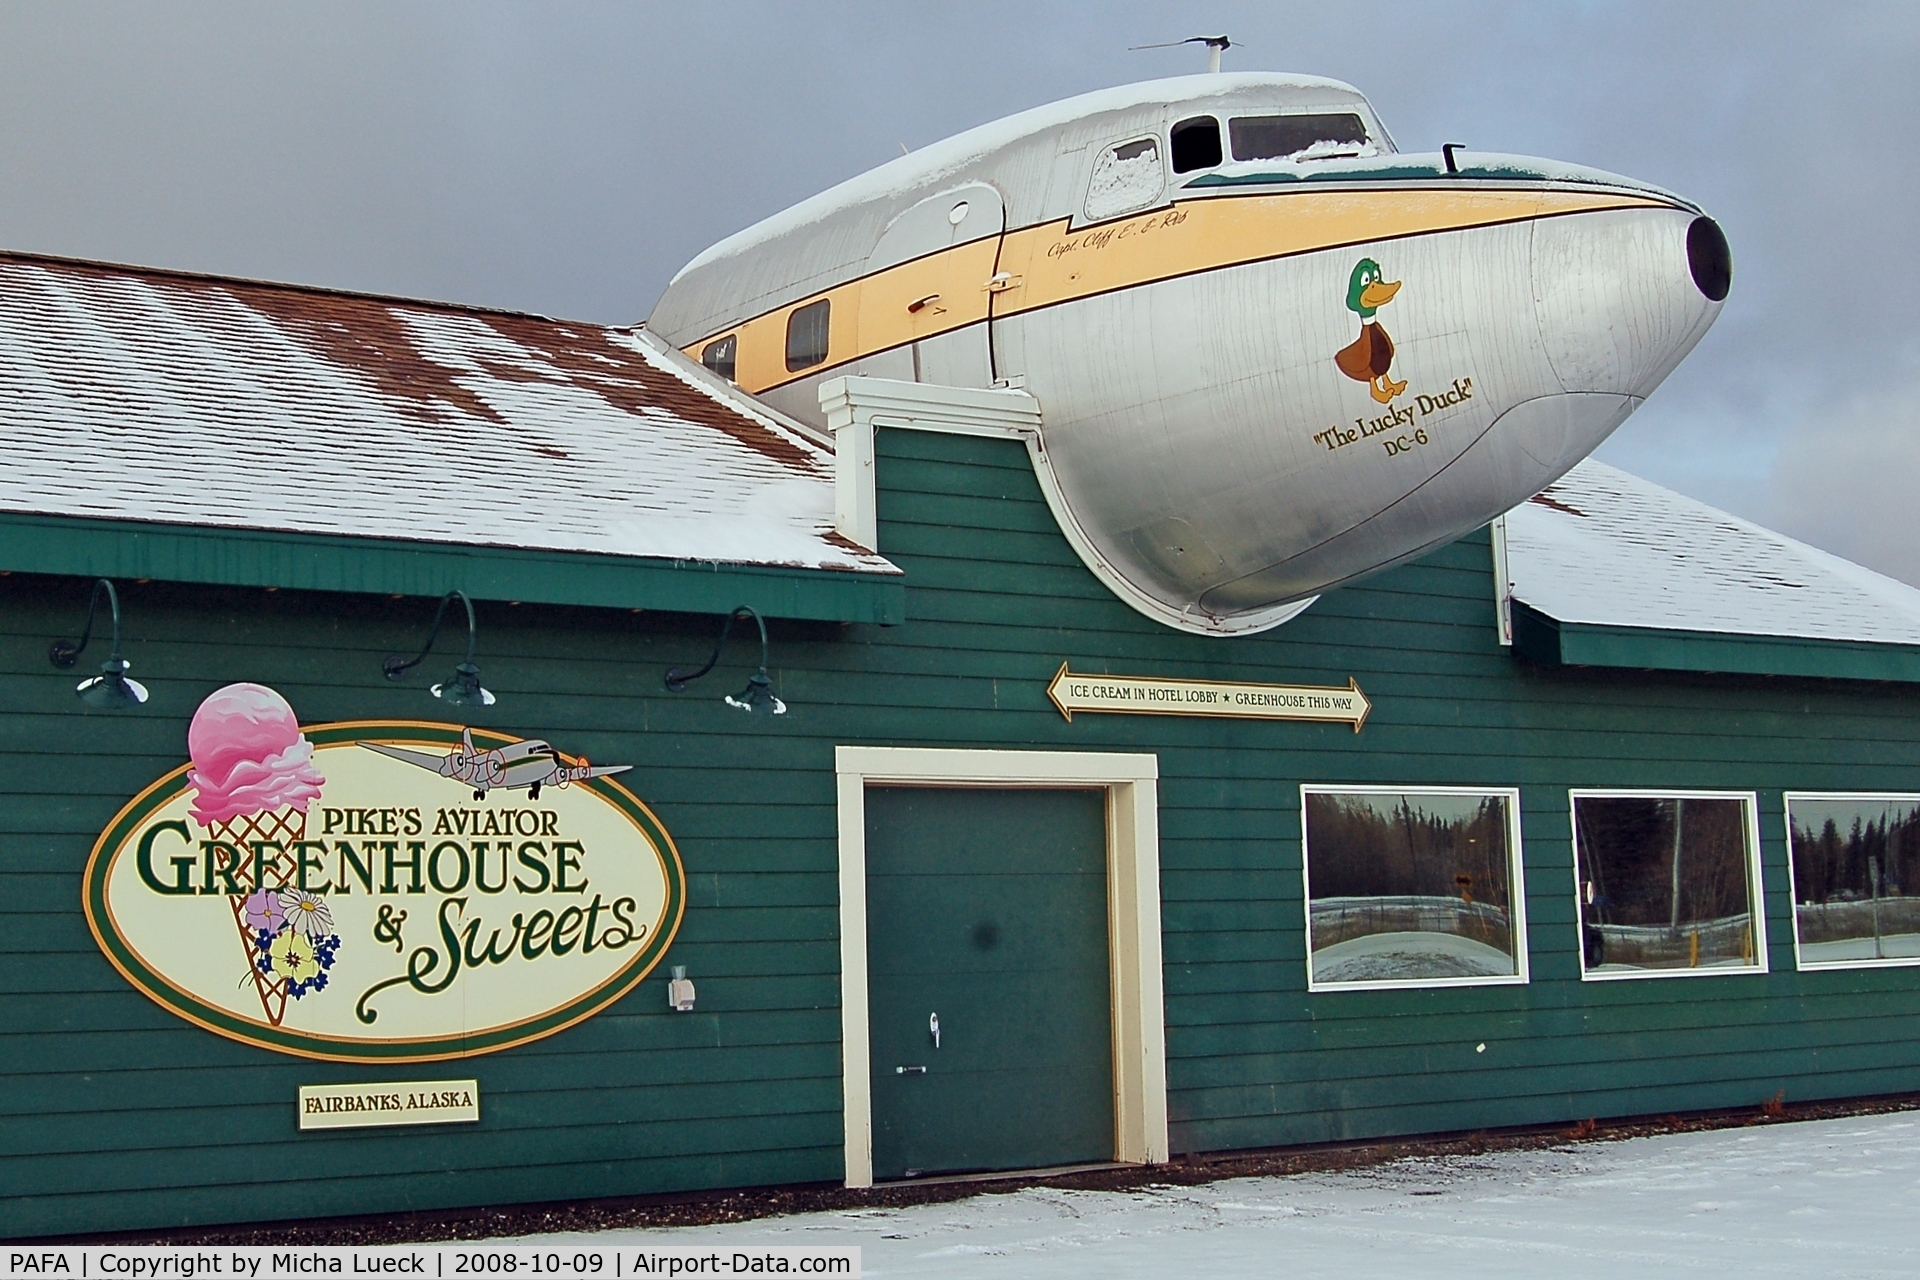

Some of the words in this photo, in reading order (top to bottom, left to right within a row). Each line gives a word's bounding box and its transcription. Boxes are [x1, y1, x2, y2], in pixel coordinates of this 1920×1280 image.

[1082, 228, 1115, 250] Cliff
[1355, 404, 1415, 438] Lucky
[1382, 428, 1429, 457] DC-6
[1069, 684, 1090, 698] ICE
[1092, 687, 1131, 700] CREAM
[1134, 688, 1146, 701] IN
[1148, 688, 1183, 702] HOTEL
[1186, 690, 1218, 704] LOBBY
[1235, 693, 1306, 708] GREENHOUSE
[1307, 696, 1331, 709] THIS
[1332, 698, 1352, 710] WAY
[321, 807, 423, 836] PIKE'S
[432, 807, 560, 837] AVIATOR
[135, 819, 590, 896] GREENHOUSE
[374, 904, 408, 953] &
[355, 895, 647, 1026] Sweets
[304, 1093, 403, 1114] FAIRBANKS,
[405, 1091, 474, 1111] ALASKA
